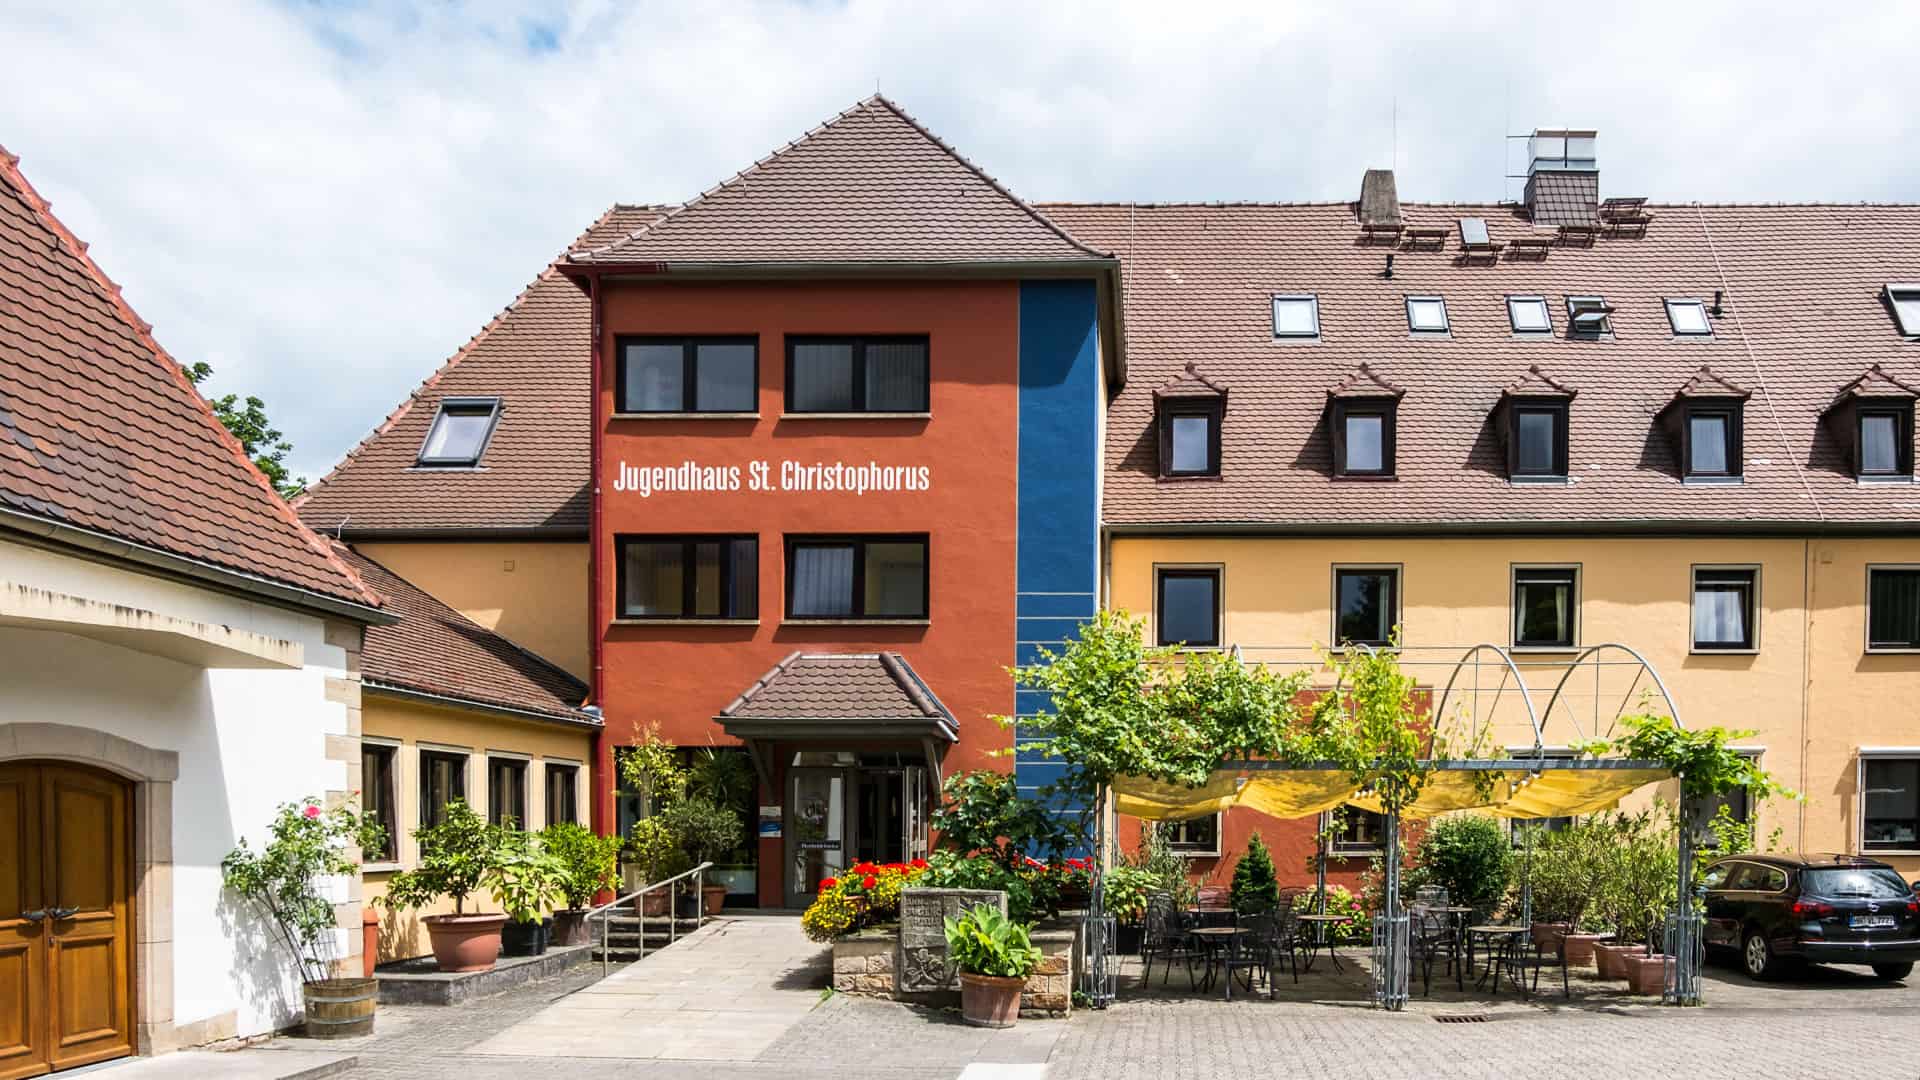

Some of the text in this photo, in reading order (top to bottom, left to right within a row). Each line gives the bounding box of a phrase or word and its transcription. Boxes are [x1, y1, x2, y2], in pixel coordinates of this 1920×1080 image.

[613, 460, 930, 498] Jugendhaus St. Christophorus
